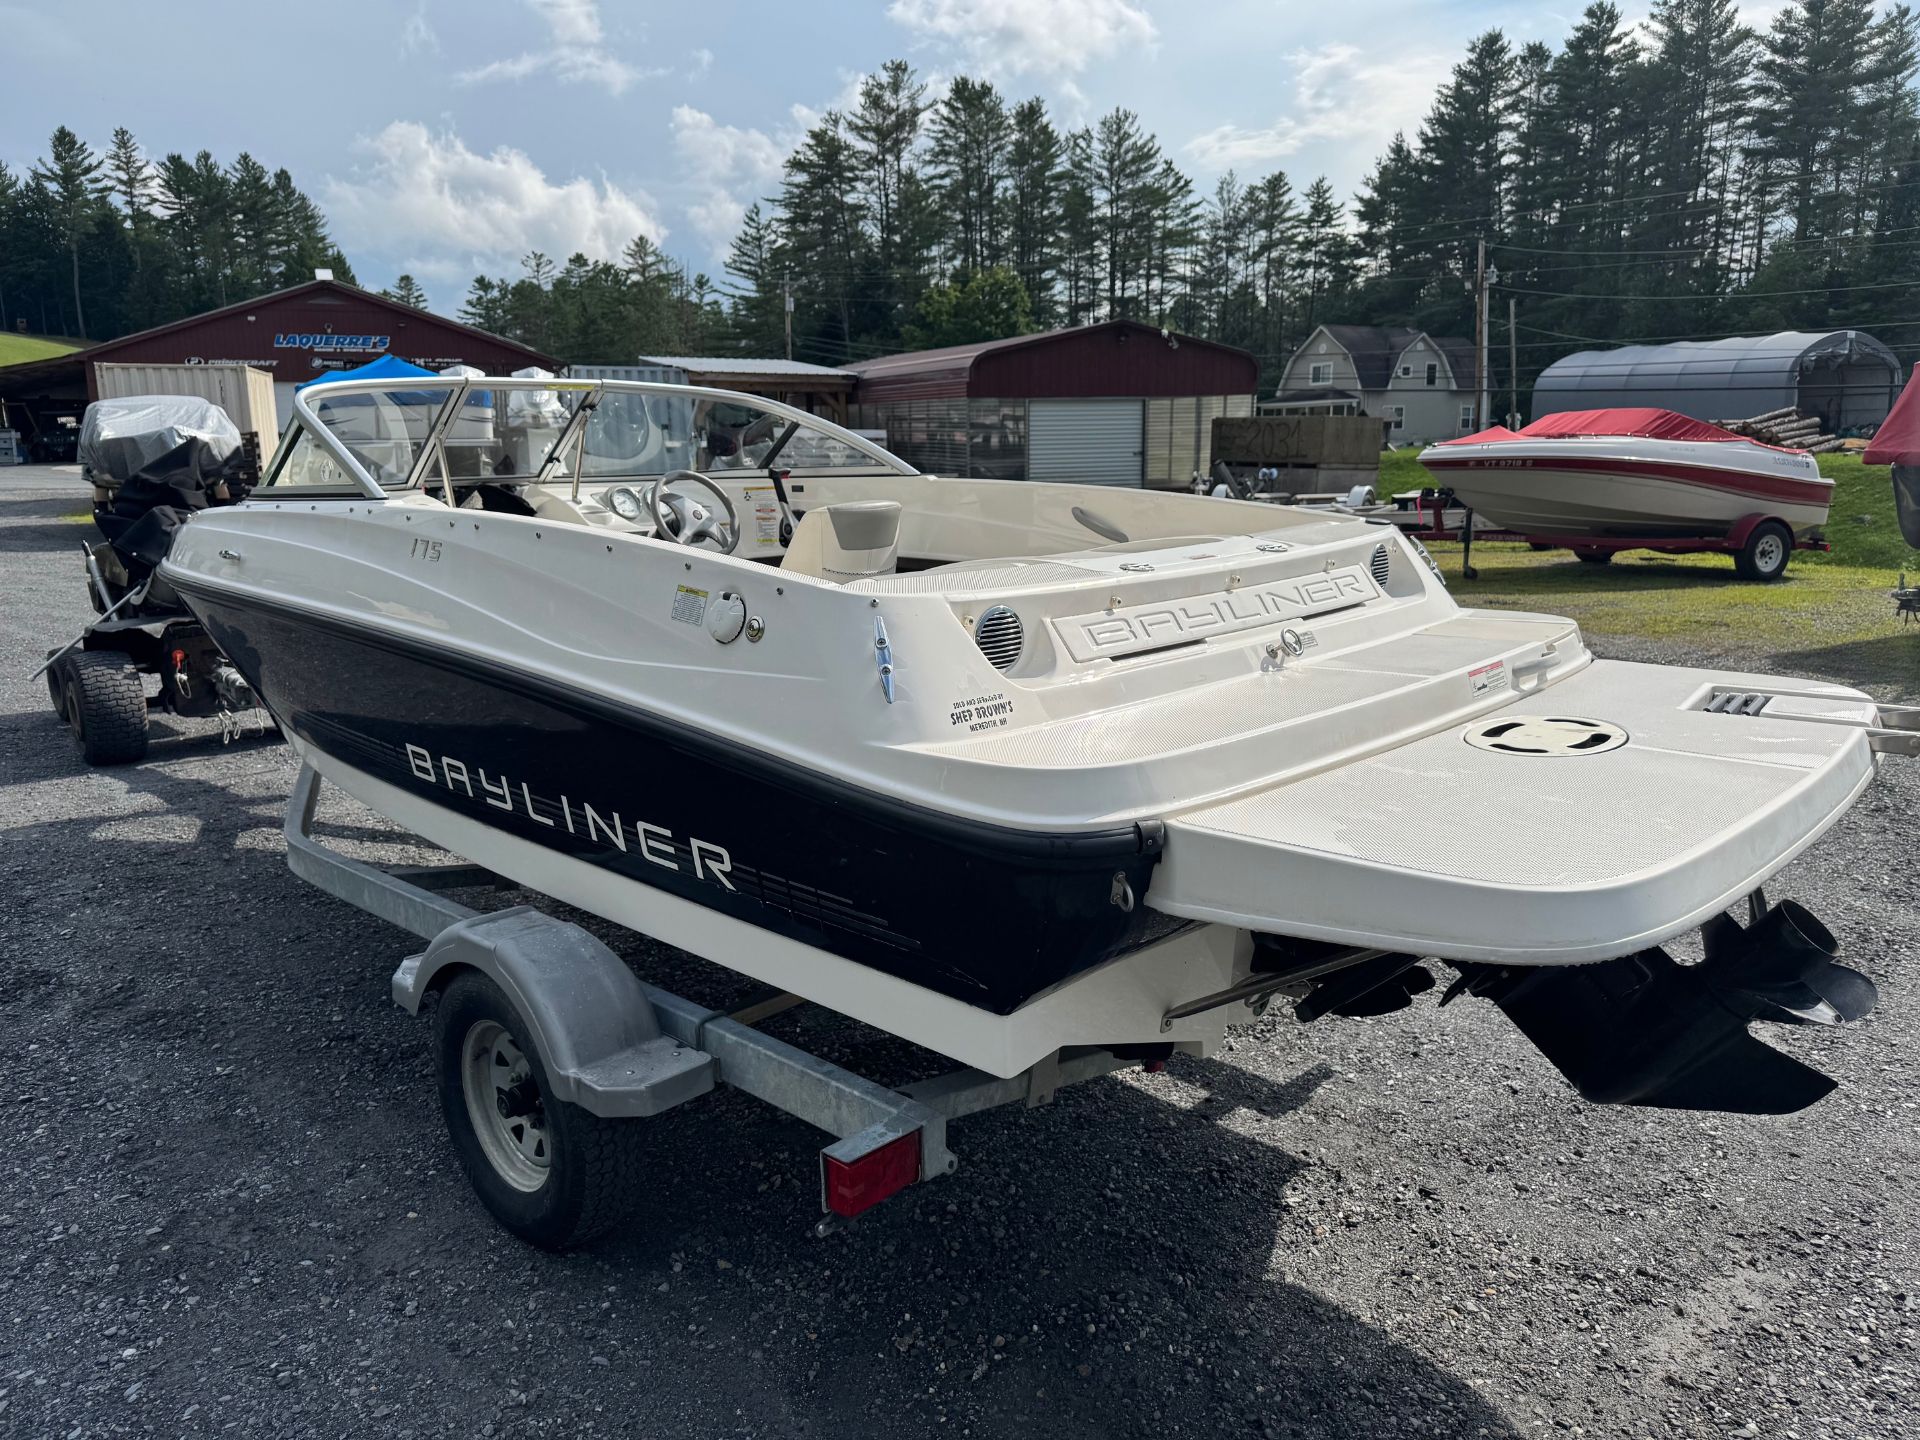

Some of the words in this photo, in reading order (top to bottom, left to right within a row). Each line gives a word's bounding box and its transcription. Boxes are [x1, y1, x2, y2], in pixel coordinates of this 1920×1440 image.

[274, 334, 390, 349] LAQUERRE'S
[410, 538, 443, 562] 175
[1080, 573, 1369, 648] BAYLINER
[950, 708, 973, 726] SHEP
[974, 700, 1014, 719] BROWN'S
[405, 743, 737, 891] BAYLINER
